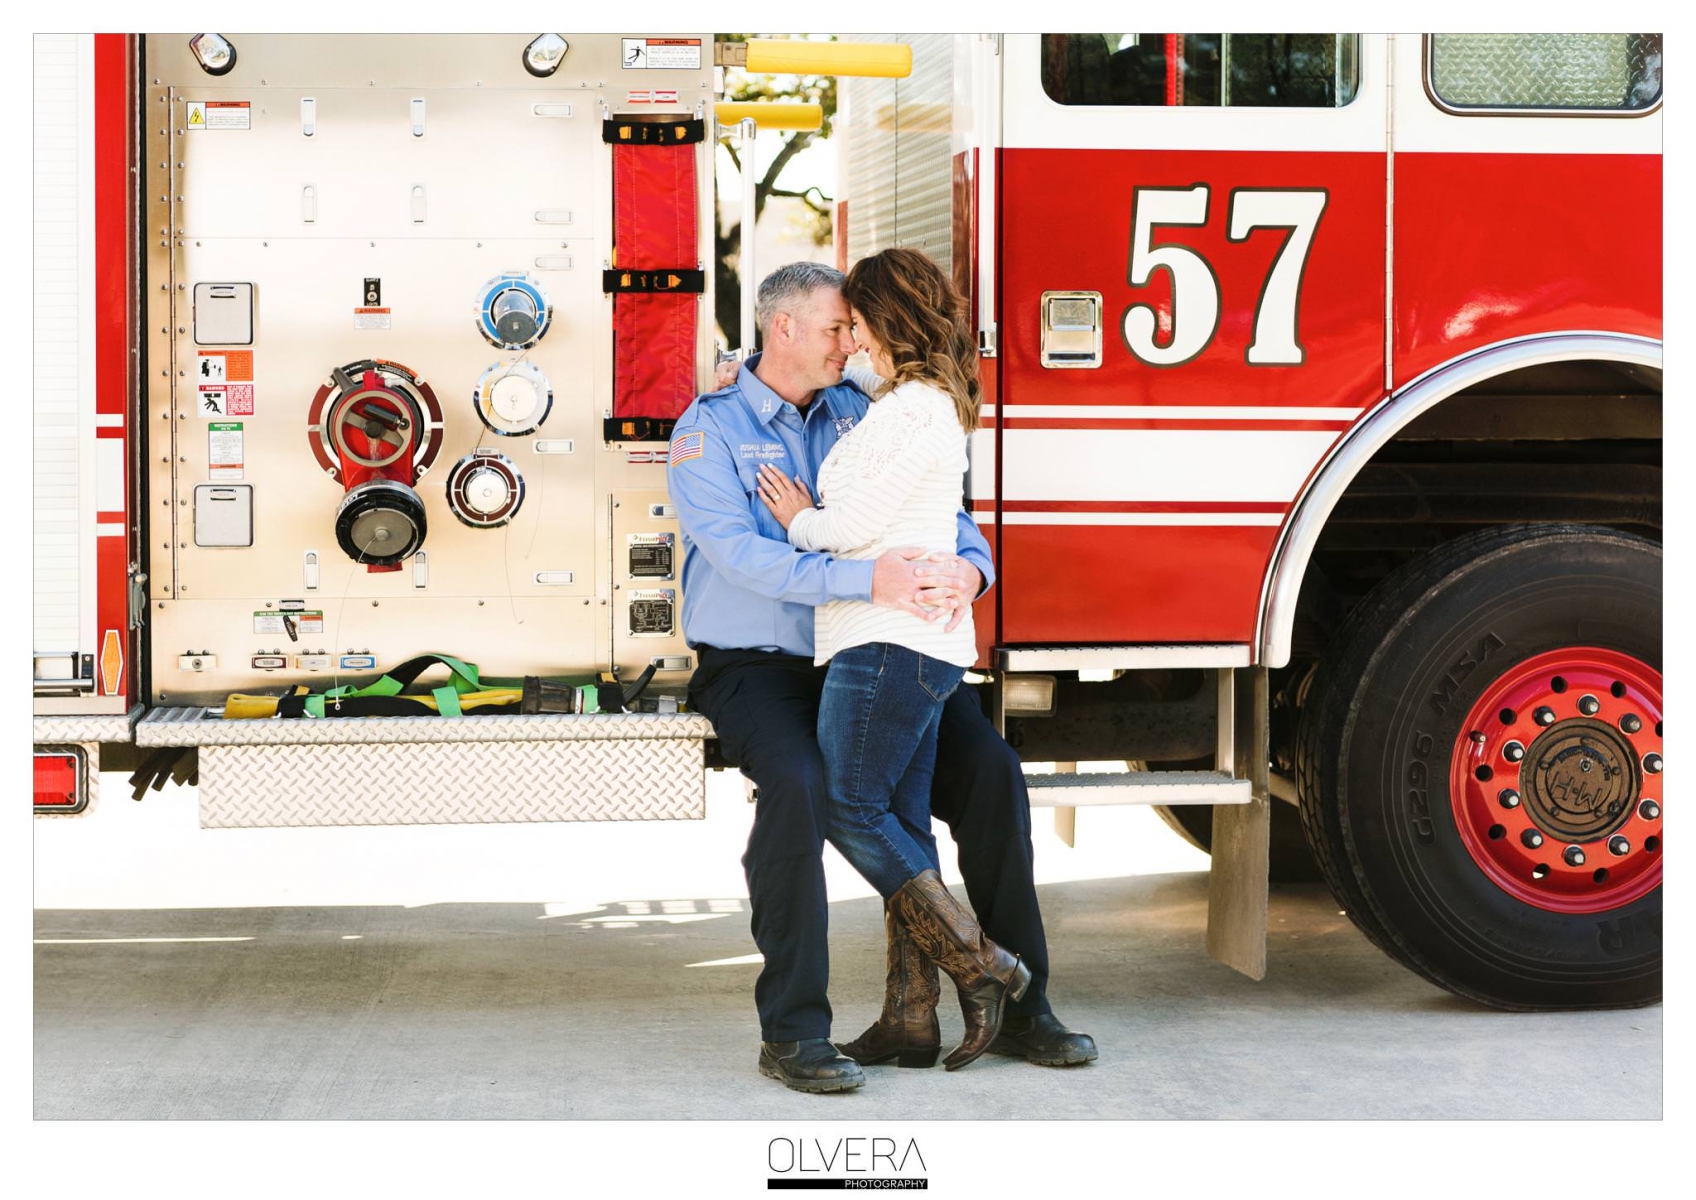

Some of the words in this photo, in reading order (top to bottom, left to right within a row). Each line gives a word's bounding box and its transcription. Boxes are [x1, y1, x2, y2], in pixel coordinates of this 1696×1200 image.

[1120, 181, 1330, 368] 57
[388, 361, 411, 372] WARNING
[761, 398, 772, 413] H
[755, 451, 785, 460] Firefighter
[1430, 631, 1506, 716] MSA
